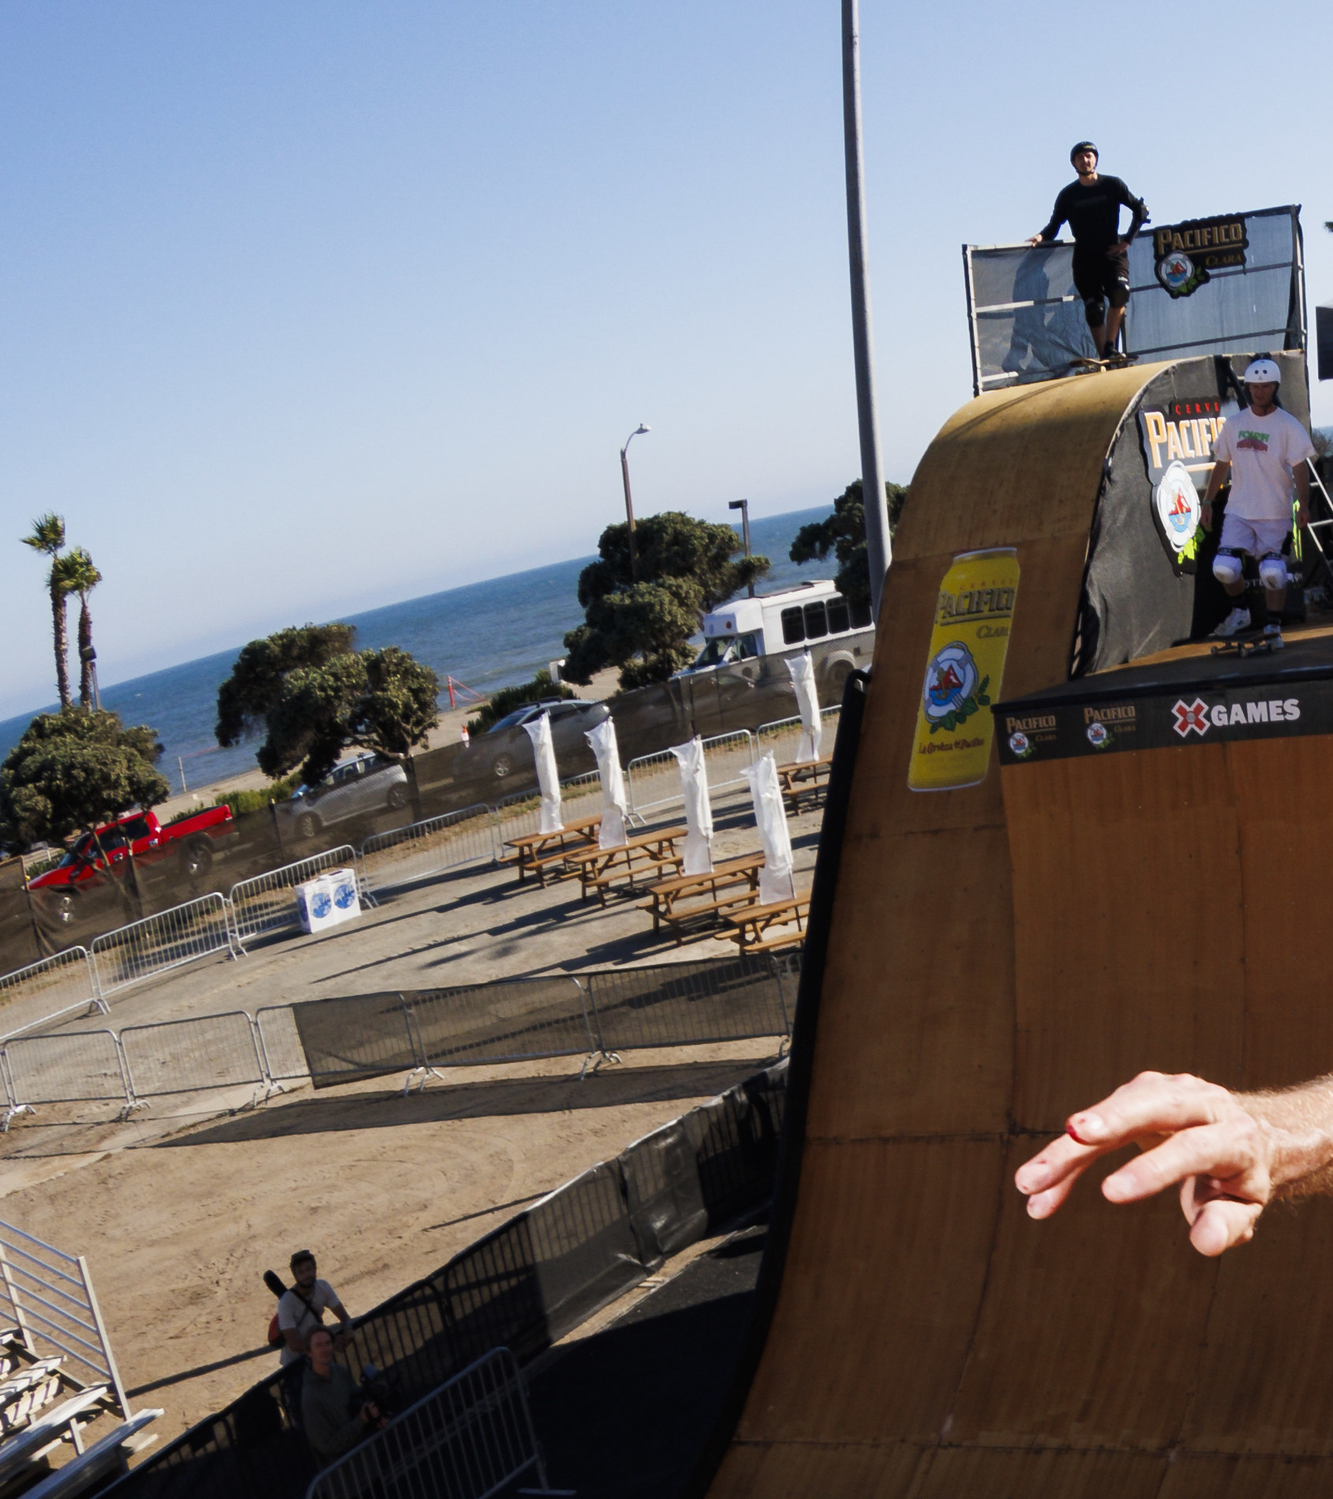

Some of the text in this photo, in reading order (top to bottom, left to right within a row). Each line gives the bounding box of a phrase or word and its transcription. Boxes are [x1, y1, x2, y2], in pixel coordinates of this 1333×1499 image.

[1156, 222, 1243, 255] PACIFICO
[1205, 253, 1242, 267] CLARA
[1084, 705, 1136, 722] PACIFICO
[1210, 699, 1300, 727] GAMES
[1006, 714, 1056, 734] PACIFICO
